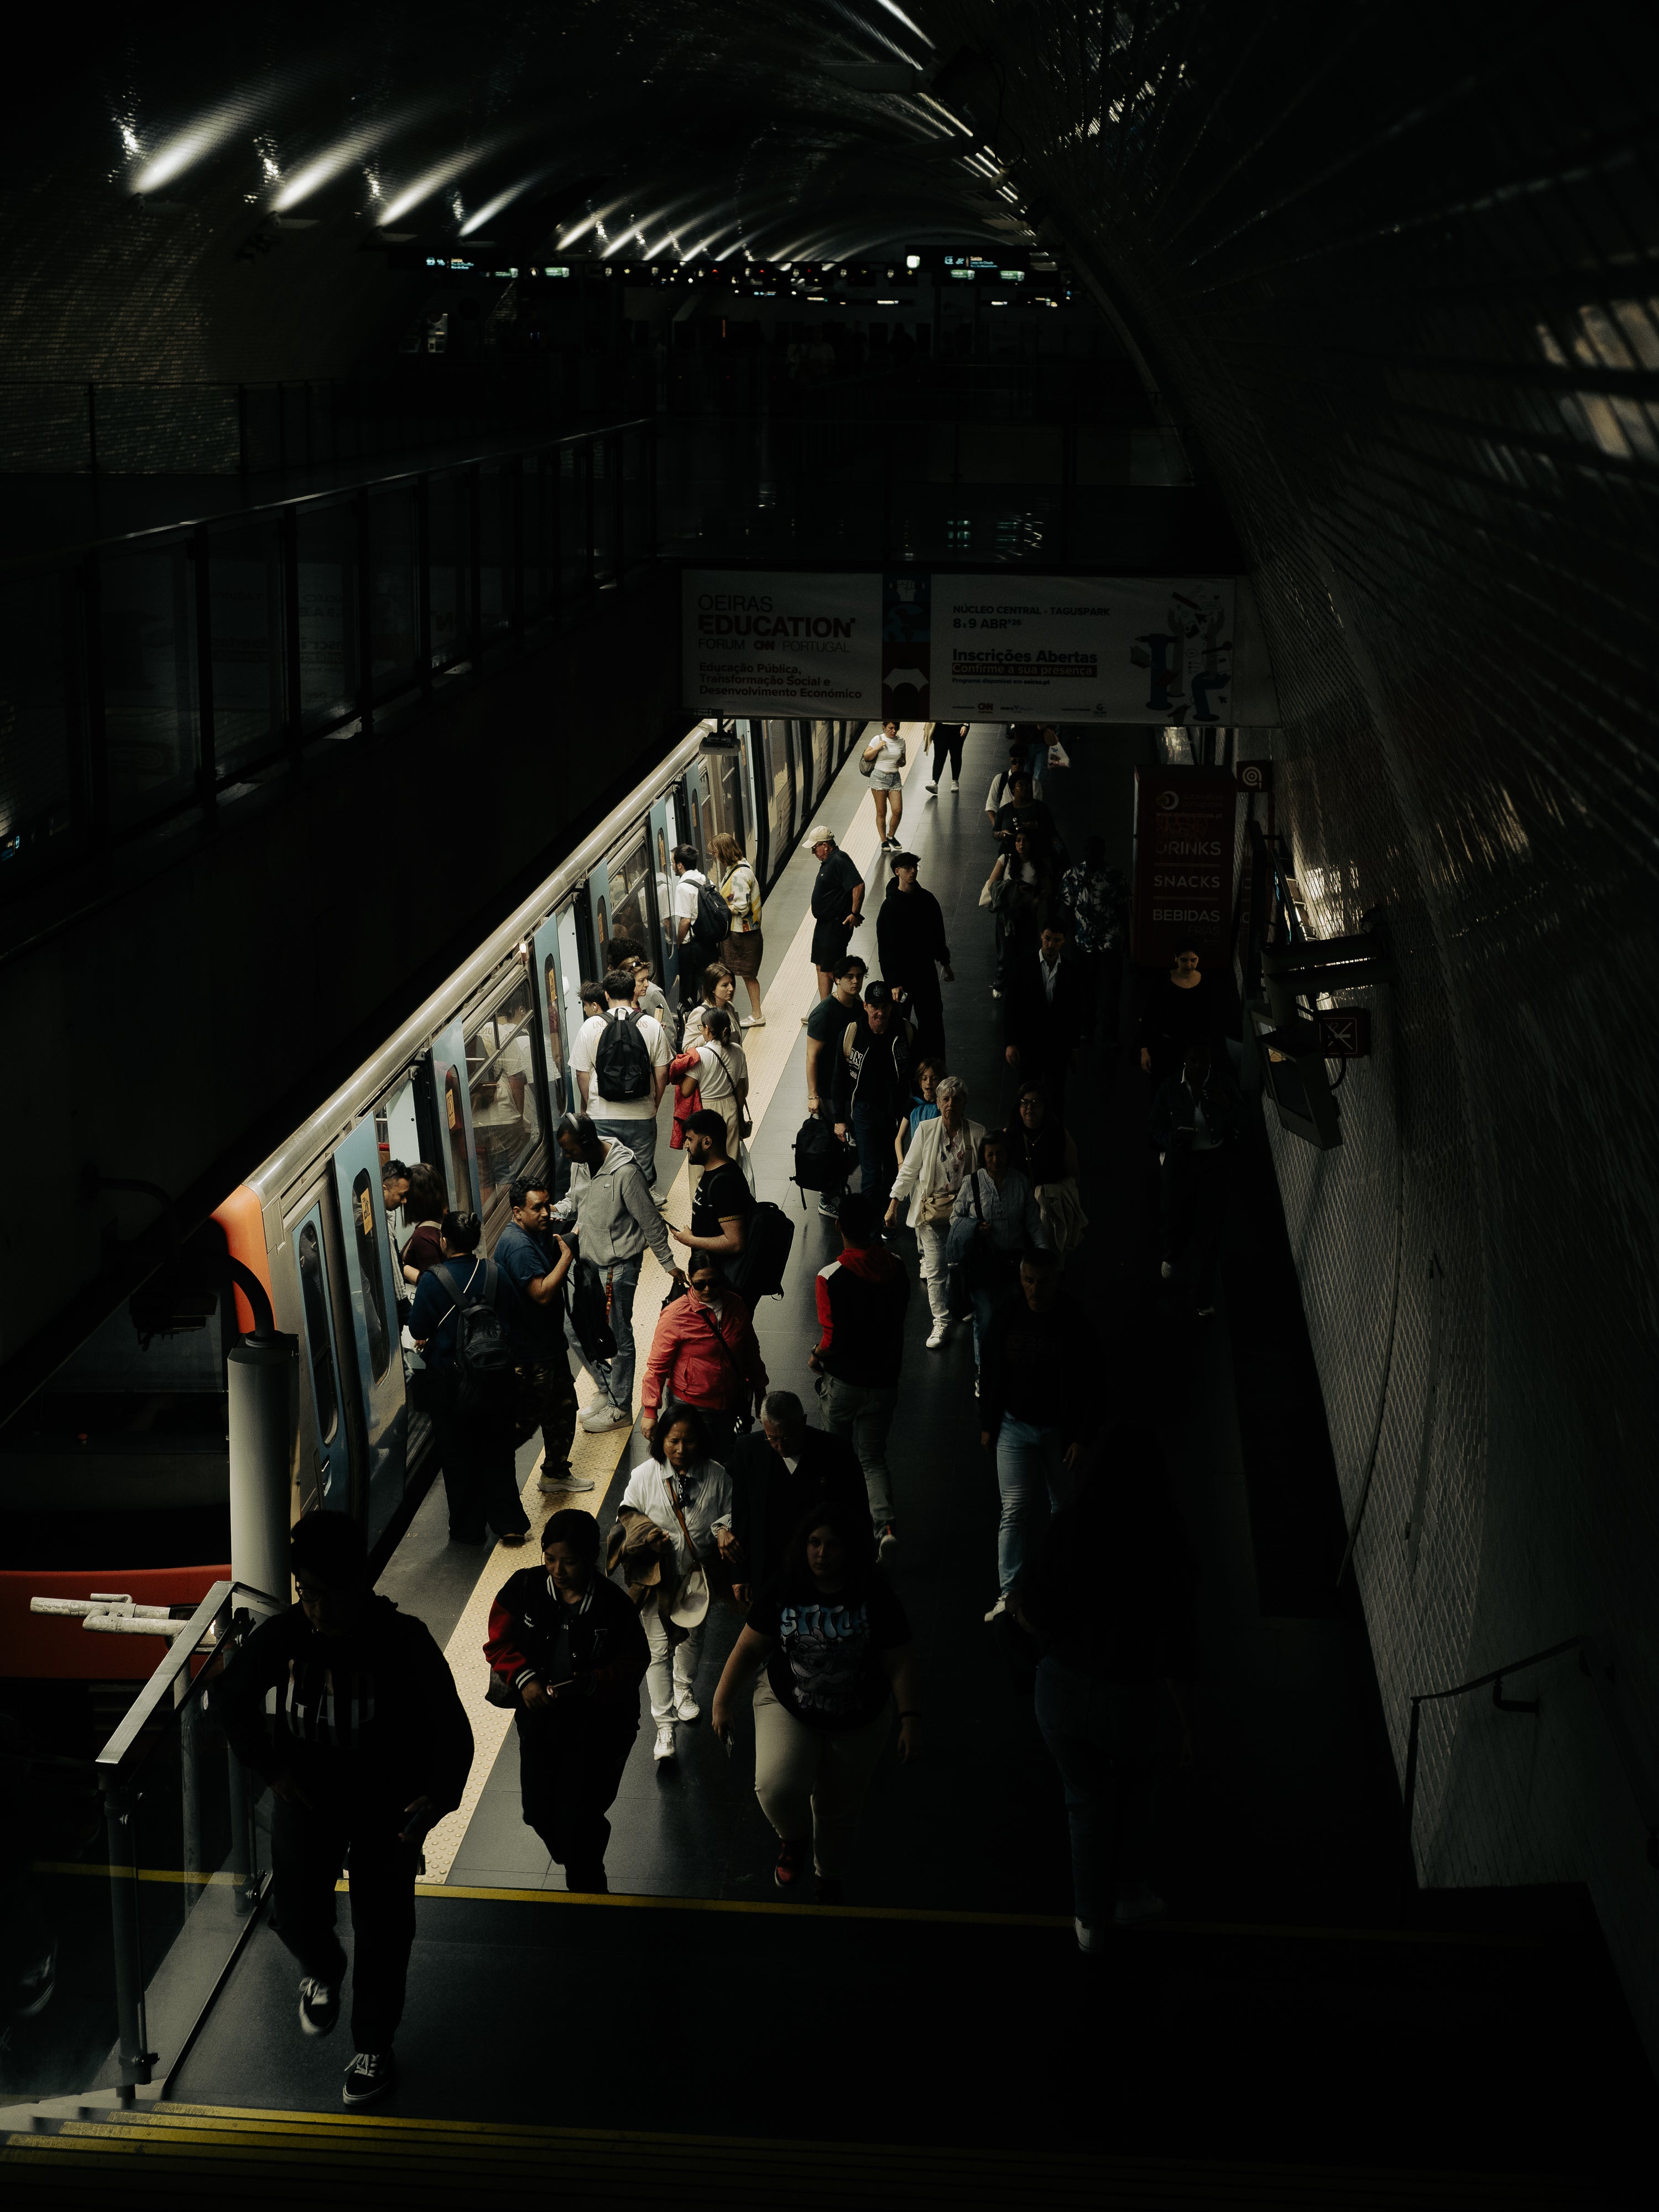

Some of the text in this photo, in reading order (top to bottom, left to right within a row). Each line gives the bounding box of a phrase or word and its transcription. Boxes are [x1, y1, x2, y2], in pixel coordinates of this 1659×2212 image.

[698, 594, 773, 612] OEIRAS
[953, 604, 994, 614] NÚCLEO
[997, 606, 1041, 615] CENTRAL
[1050, 607, 1110, 616] TAGUSPARK
[698, 614, 855, 638] EDUCATION
[953, 618, 961, 628] 8
[969, 618, 977, 628] 9
[698, 638, 851, 653] FORUM CNN PORTUGAL
[953, 648, 1098, 664] Inscrições Abertas
[700, 662, 801, 675] Educação Pública,
[952, 664, 1005, 674] Confirme
[1018, 667, 1038, 675] sua
[1040, 666, 1093, 677] presença
[700, 674, 784, 687] Transformação
[787, 676, 821, 687] Social
[700, 686, 862, 698] Desenvolvimento Económico
[1156, 841, 1222, 855] DRINKS
[1154, 875, 1220, 888] SNACKS
[1152, 909, 1221, 922] BEBIDAS
[1188, 925, 1220, 935] FRIAS
